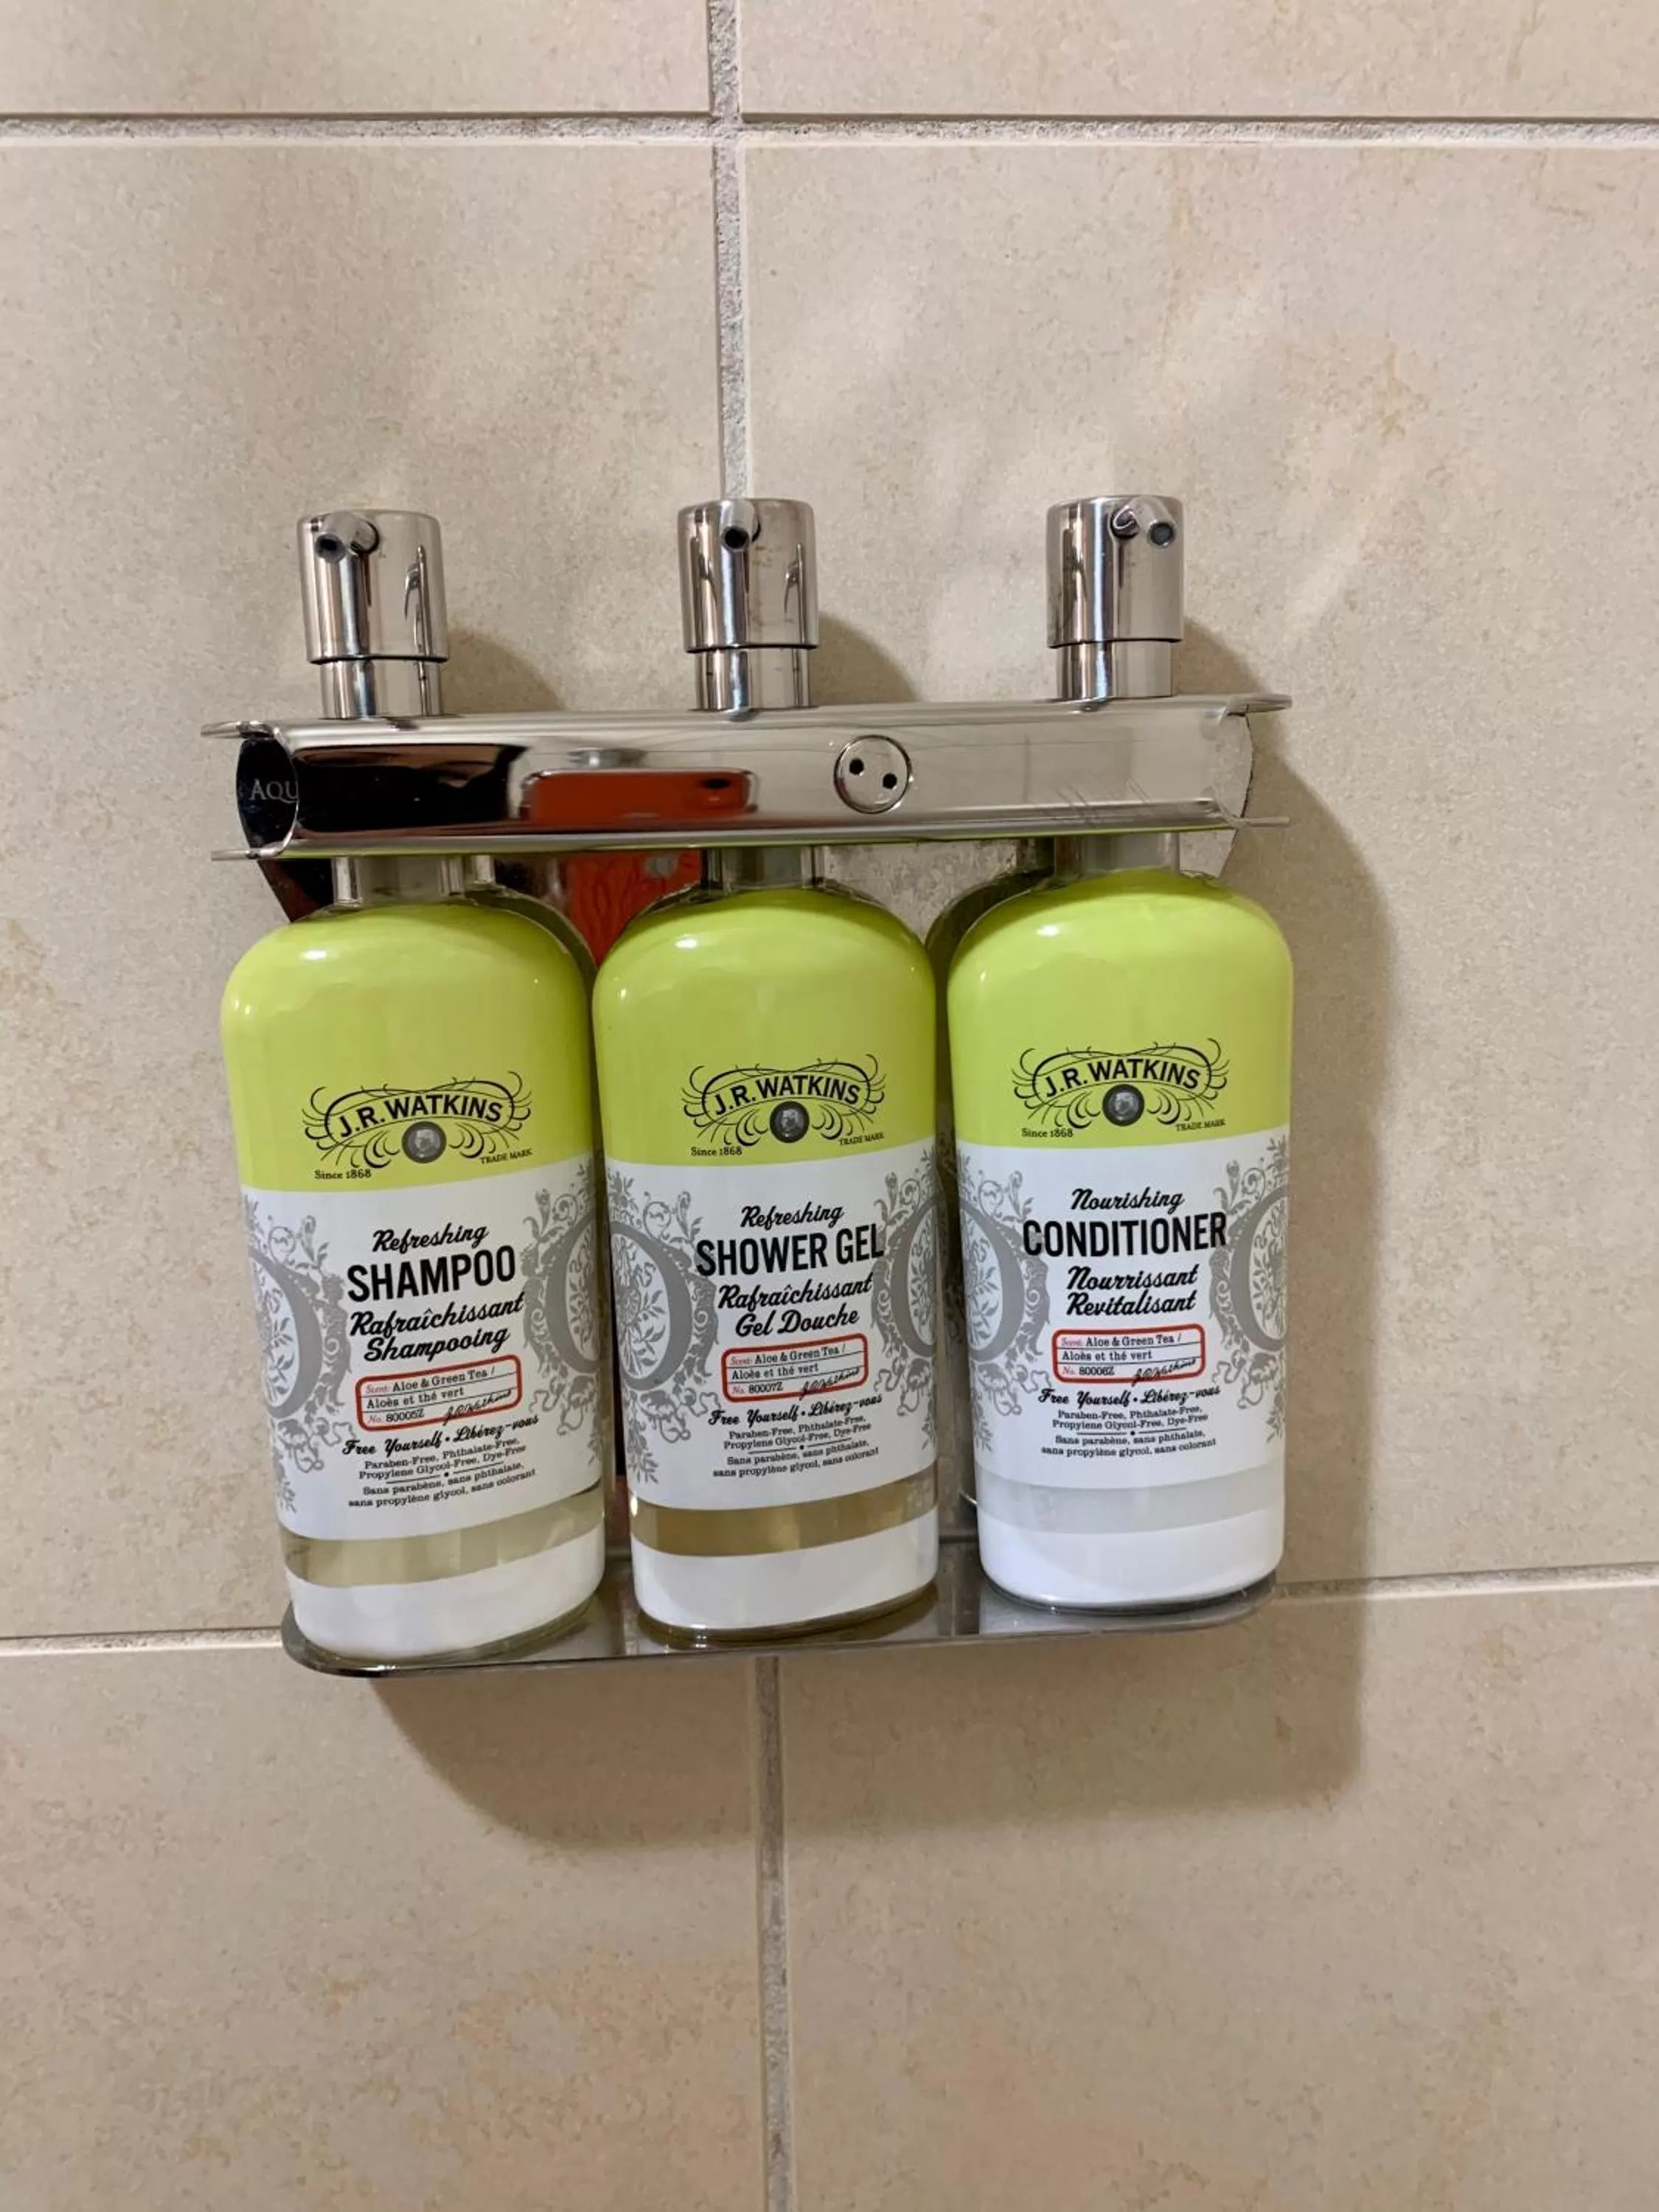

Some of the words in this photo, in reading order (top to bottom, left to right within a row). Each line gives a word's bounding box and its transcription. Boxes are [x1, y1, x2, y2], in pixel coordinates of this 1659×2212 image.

[1088, 1059, 1200, 1089] WATKINS
[756, 1075, 861, 1105] WATKINS
[384, 1093, 502, 1121] WATKINS
[1021, 1127, 1047, 1138] Since
[1050, 1127, 1074, 1138] 1868
[1175, 1122, 1201, 1132] TRADE
[1204, 1119, 1225, 1129] MARK
[691, 1147, 717, 1156] Since
[720, 1146, 742, 1156] 1868
[839, 1137, 863, 1146] TRADE
[864, 1133, 885, 1141] MARK
[480, 1155, 507, 1164] TRADE
[509, 1150, 532, 1158] MARK
[315, 1170, 343, 1179] Since
[346, 1170, 371, 1178] 1868
[1071, 1187, 1184, 1214] Nourishing
[740, 1201, 844, 1231] Refreshing
[372, 1222, 488, 1253] Refreshing
[1023, 1211, 1226, 1258] CONDITIONER
[696, 1232, 827, 1276] SHOWER
[836, 1223, 884, 1265] GEL
[347, 1245, 515, 1302] SHAMPOO
[1066, 1264, 1200, 1290] Nourrissant
[718, 1272, 873, 1312] Rafraîchissant
[1066, 1290, 1197, 1316] Revitalisant
[349, 1292, 525, 1339] Rafraîchissant
[736, 1310, 776, 1337] Gel
[777, 1302, 860, 1334] Douche
[364, 1327, 509, 1362] Shampooing
[1085, 1338, 1110, 1347] Aloe
[1112, 1338, 1120, 1346] &
[1122, 1336, 1153, 1346] Green
[1156, 1335, 1175, 1343] Tea
[754, 1353, 778, 1363] Aloe
[780, 1353, 787, 1361] &
[790, 1349, 820, 1360] Green
[822, 1346, 839, 1354] Tea
[1062, 1351, 1091, 1361] Aloès
[1095, 1352, 1106, 1360] et
[1109, 1349, 1127, 1360] thé
[1130, 1350, 1152, 1360] vert
[392, 1382, 418, 1392] Aloe
[421, 1380, 429, 1388] &
[431, 1374, 465, 1386] Green
[467, 1370, 487, 1379] Tea
[731, 1369, 760, 1380] Aloès
[764, 1368, 774, 1377] et
[777, 1366, 794, 1376] thé
[798, 1364, 818, 1373] vert
[366, 1397, 398, 1408] Aloès
[403, 1397, 414, 1405] et
[419, 1391, 437, 1402] thé
[442, 1387, 464, 1398] vert
[1038, 1388, 1068, 1404] Free
[1077, 1391, 1130, 1408] Yourself
[1141, 1386, 1220, 1405] Libérez-vous
[709, 1410, 740, 1425] Free
[747, 1405, 799, 1428] Yourself
[808, 1394, 883, 1417] Libérez-vous
[1053, 1420, 1102, 1430] Propylene
[1167, 1413, 1208, 1427] Dye-Free
[342, 1440, 376, 1455] Free
[385, 1430, 442, 1457] Yourself
[454, 1416, 538, 1441] Libérez-vous
[724, 1438, 773, 1450] Propylene
[834, 1422, 872, 1438] Dye-Free
[1042, 1447, 1063, 1455] sans
[1155, 1445, 1177, 1453] sans
[1179, 1439, 1216, 1452] colorant
[1056, 1436, 1079, 1444] Sans
[1133, 1436, 1156, 1444] sans
[359, 1464, 413, 1480] Propylene
[484, 1445, 526, 1461] Dye-Free
[713, 1469, 737, 1477] sans
[822, 1456, 843, 1466] sans
[845, 1447, 879, 1462] colorant
[727, 1457, 751, 1465] Sans
[801, 1447, 823, 1456] sans
[348, 1498, 373, 1506] sans
[471, 1482, 494, 1492] sans
[497, 1469, 535, 1486] colorant
[363, 1486, 389, 1495] Sans
[448, 1475, 472, 1485] sans
